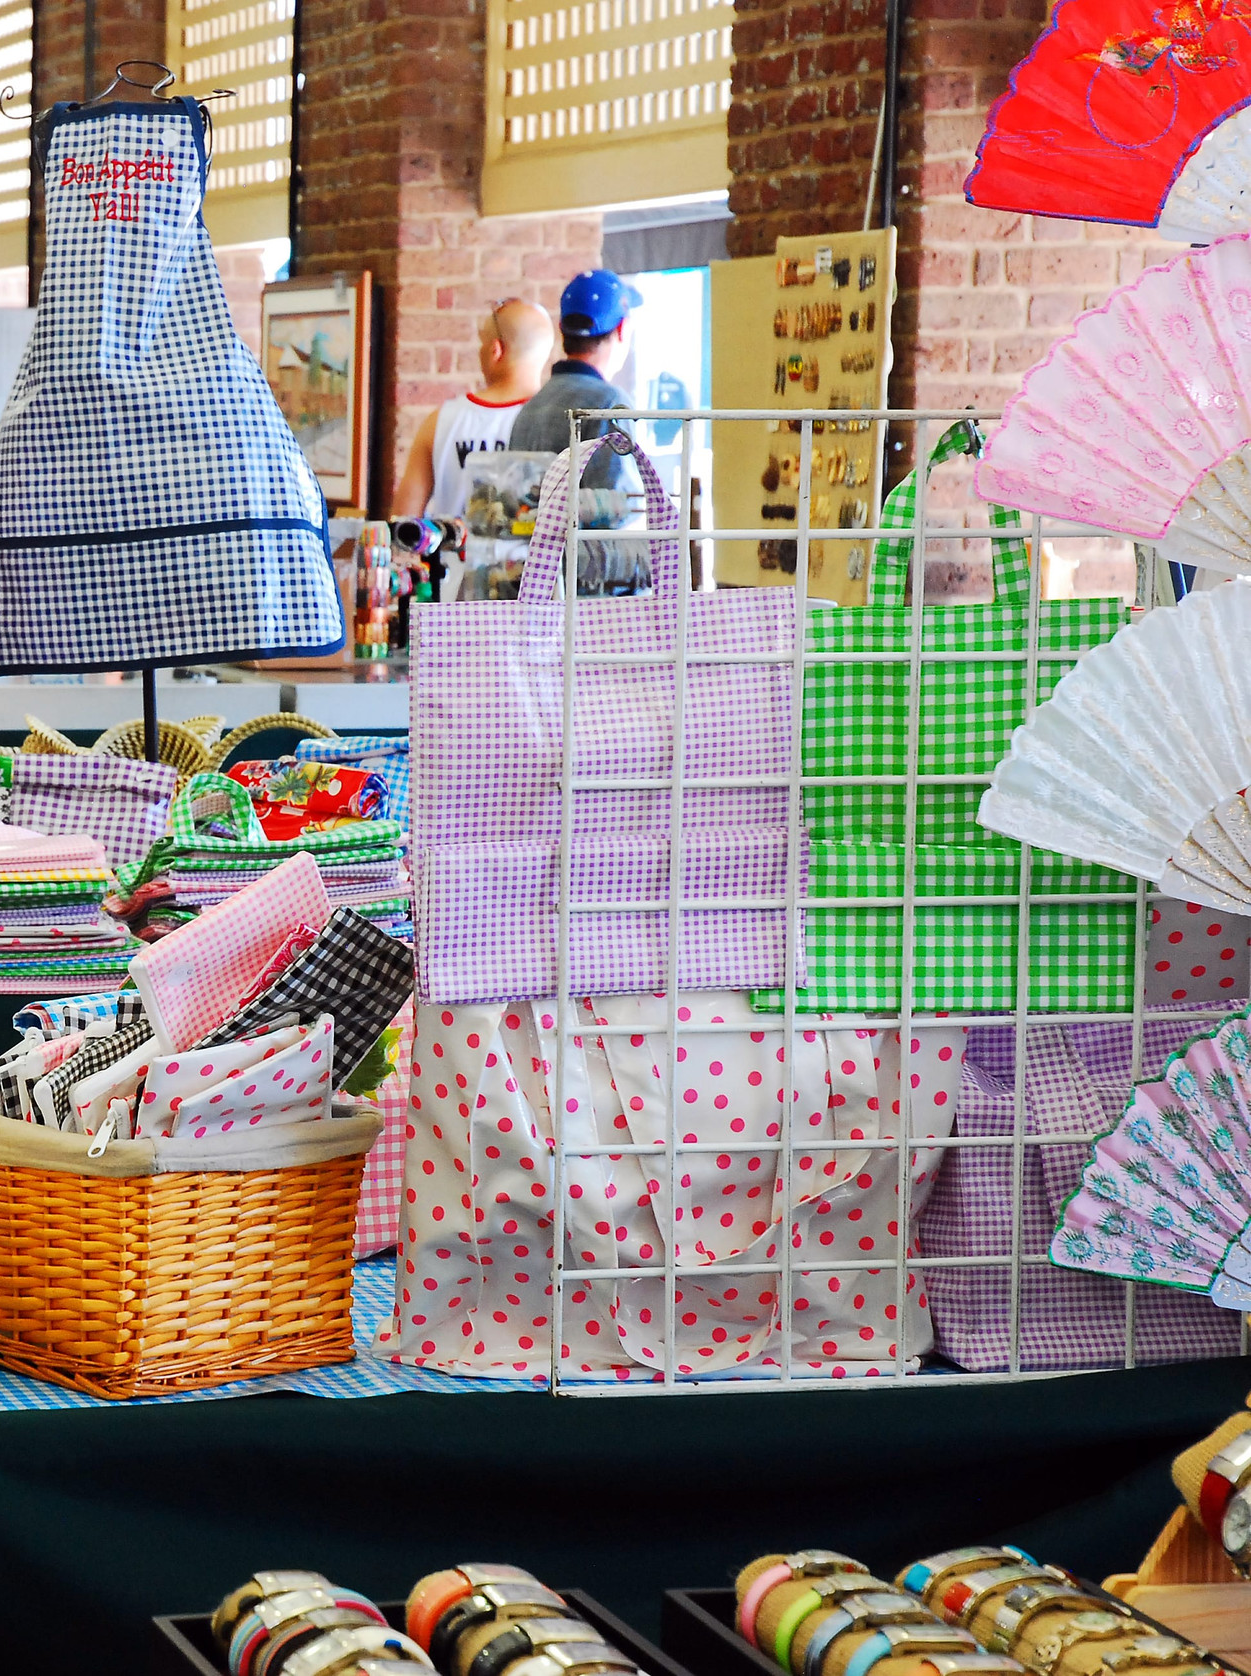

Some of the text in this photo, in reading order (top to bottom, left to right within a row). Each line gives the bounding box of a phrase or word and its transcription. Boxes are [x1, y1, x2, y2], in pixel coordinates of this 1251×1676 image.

[61, 149, 175, 190] Bon Appétit
[89, 191, 140, 222] Y'all!
